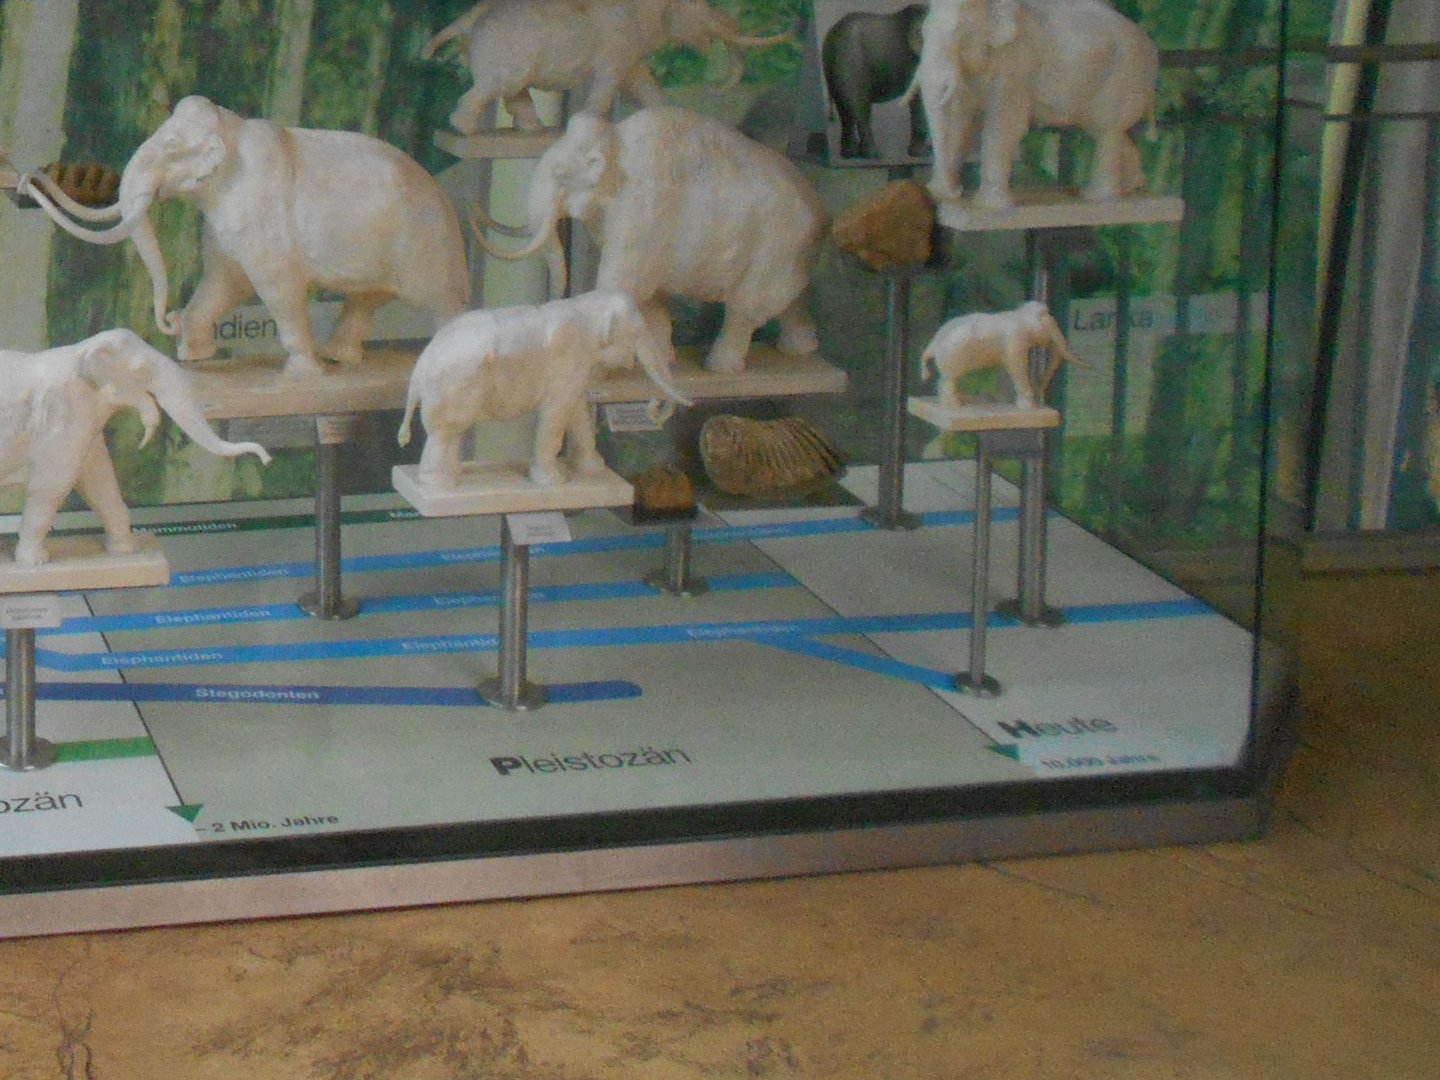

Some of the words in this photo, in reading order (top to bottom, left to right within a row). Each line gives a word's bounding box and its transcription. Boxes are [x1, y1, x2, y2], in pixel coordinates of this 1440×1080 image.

[154, 608, 271, 624] Elephantiden
[100, 650, 224, 666] Elephantiden
[195, 687, 320, 700] Stegodonten
[489, 746, 693, 776] Pleistozän
[211, 823, 225, 832] 2
[229, 819, 278, 832] Mio.
[282, 813, 340, 828] Jahre
